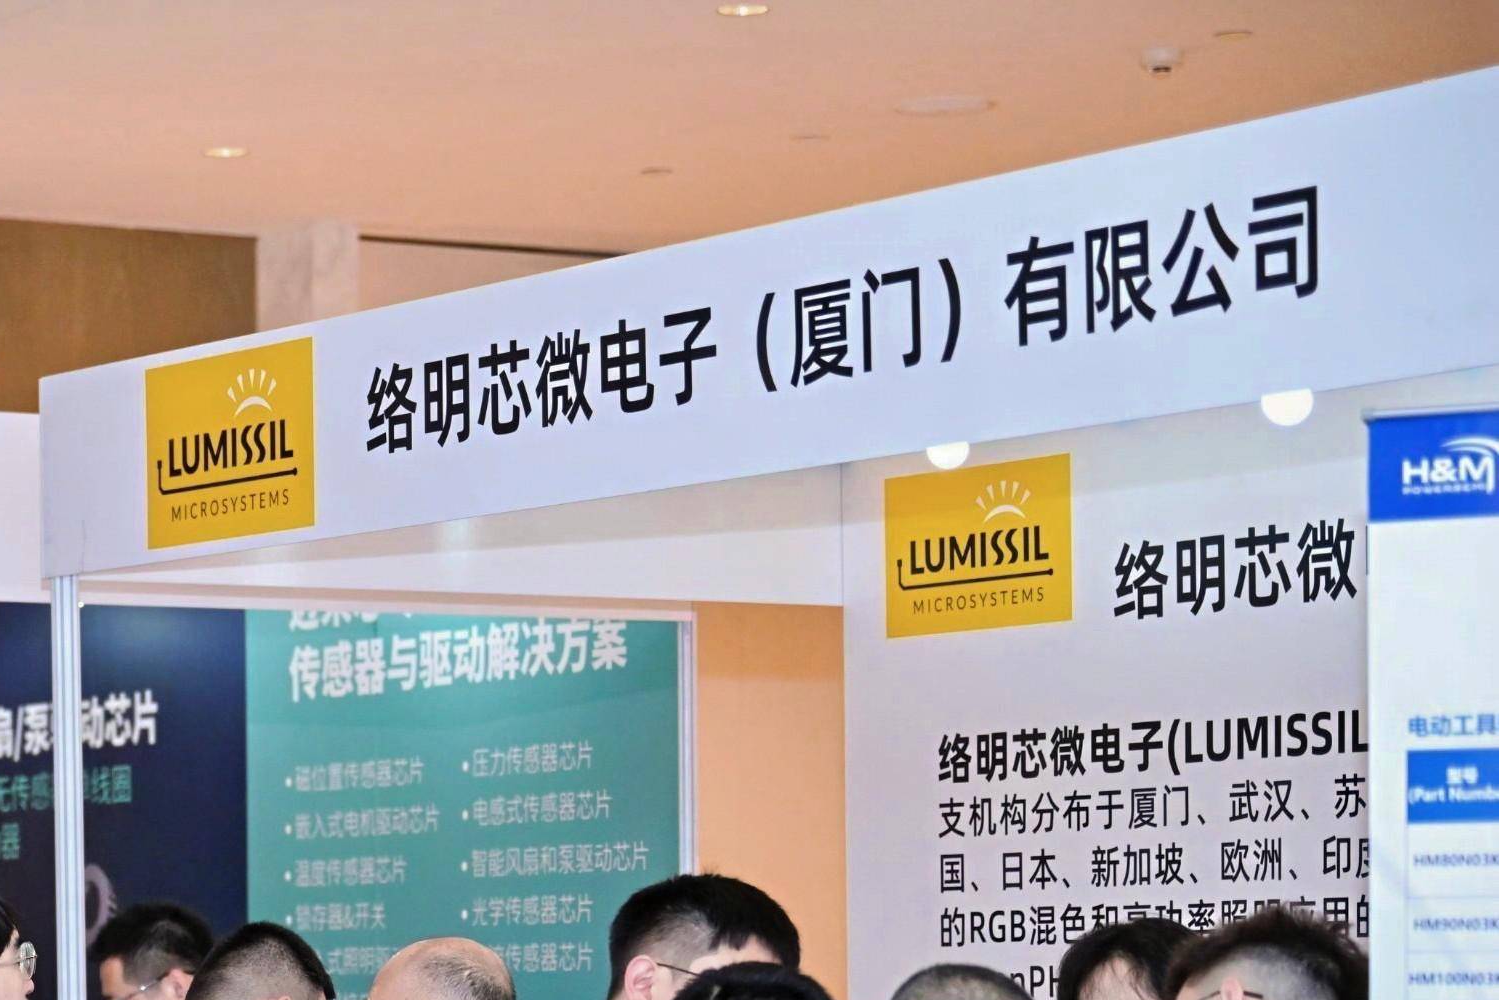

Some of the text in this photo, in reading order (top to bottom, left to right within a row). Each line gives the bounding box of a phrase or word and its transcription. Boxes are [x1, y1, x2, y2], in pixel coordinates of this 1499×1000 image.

[168, 419, 294, 478] LUMISSIL
[1402, 455, 1496, 494] H&M
[171, 488, 289, 522] MICROSYSTEMS
[909, 525, 1050, 575] LUMISSIL
[1113, 518, 1369, 621] 络明芯微
[913, 586, 1045, 615] MICROSYSTEMS
[289, 618, 627, 702] 传感器与驱动解决方案
[1407, 714, 1499, 737] 电动工具
[472, 740, 594, 777] 压力传感器芯片
[938, 709, 1369, 784] 络明芯微电子(LUMISSIL
[473, 789, 613, 826] 电感式传感器芯片
[938, 772, 1368, 839] 支机构分布于厦门、武汉、苏
[471, 840, 649, 878] 智能风扇和泵驱动芯片
[472, 894, 594, 927] 光学传感器芯片
